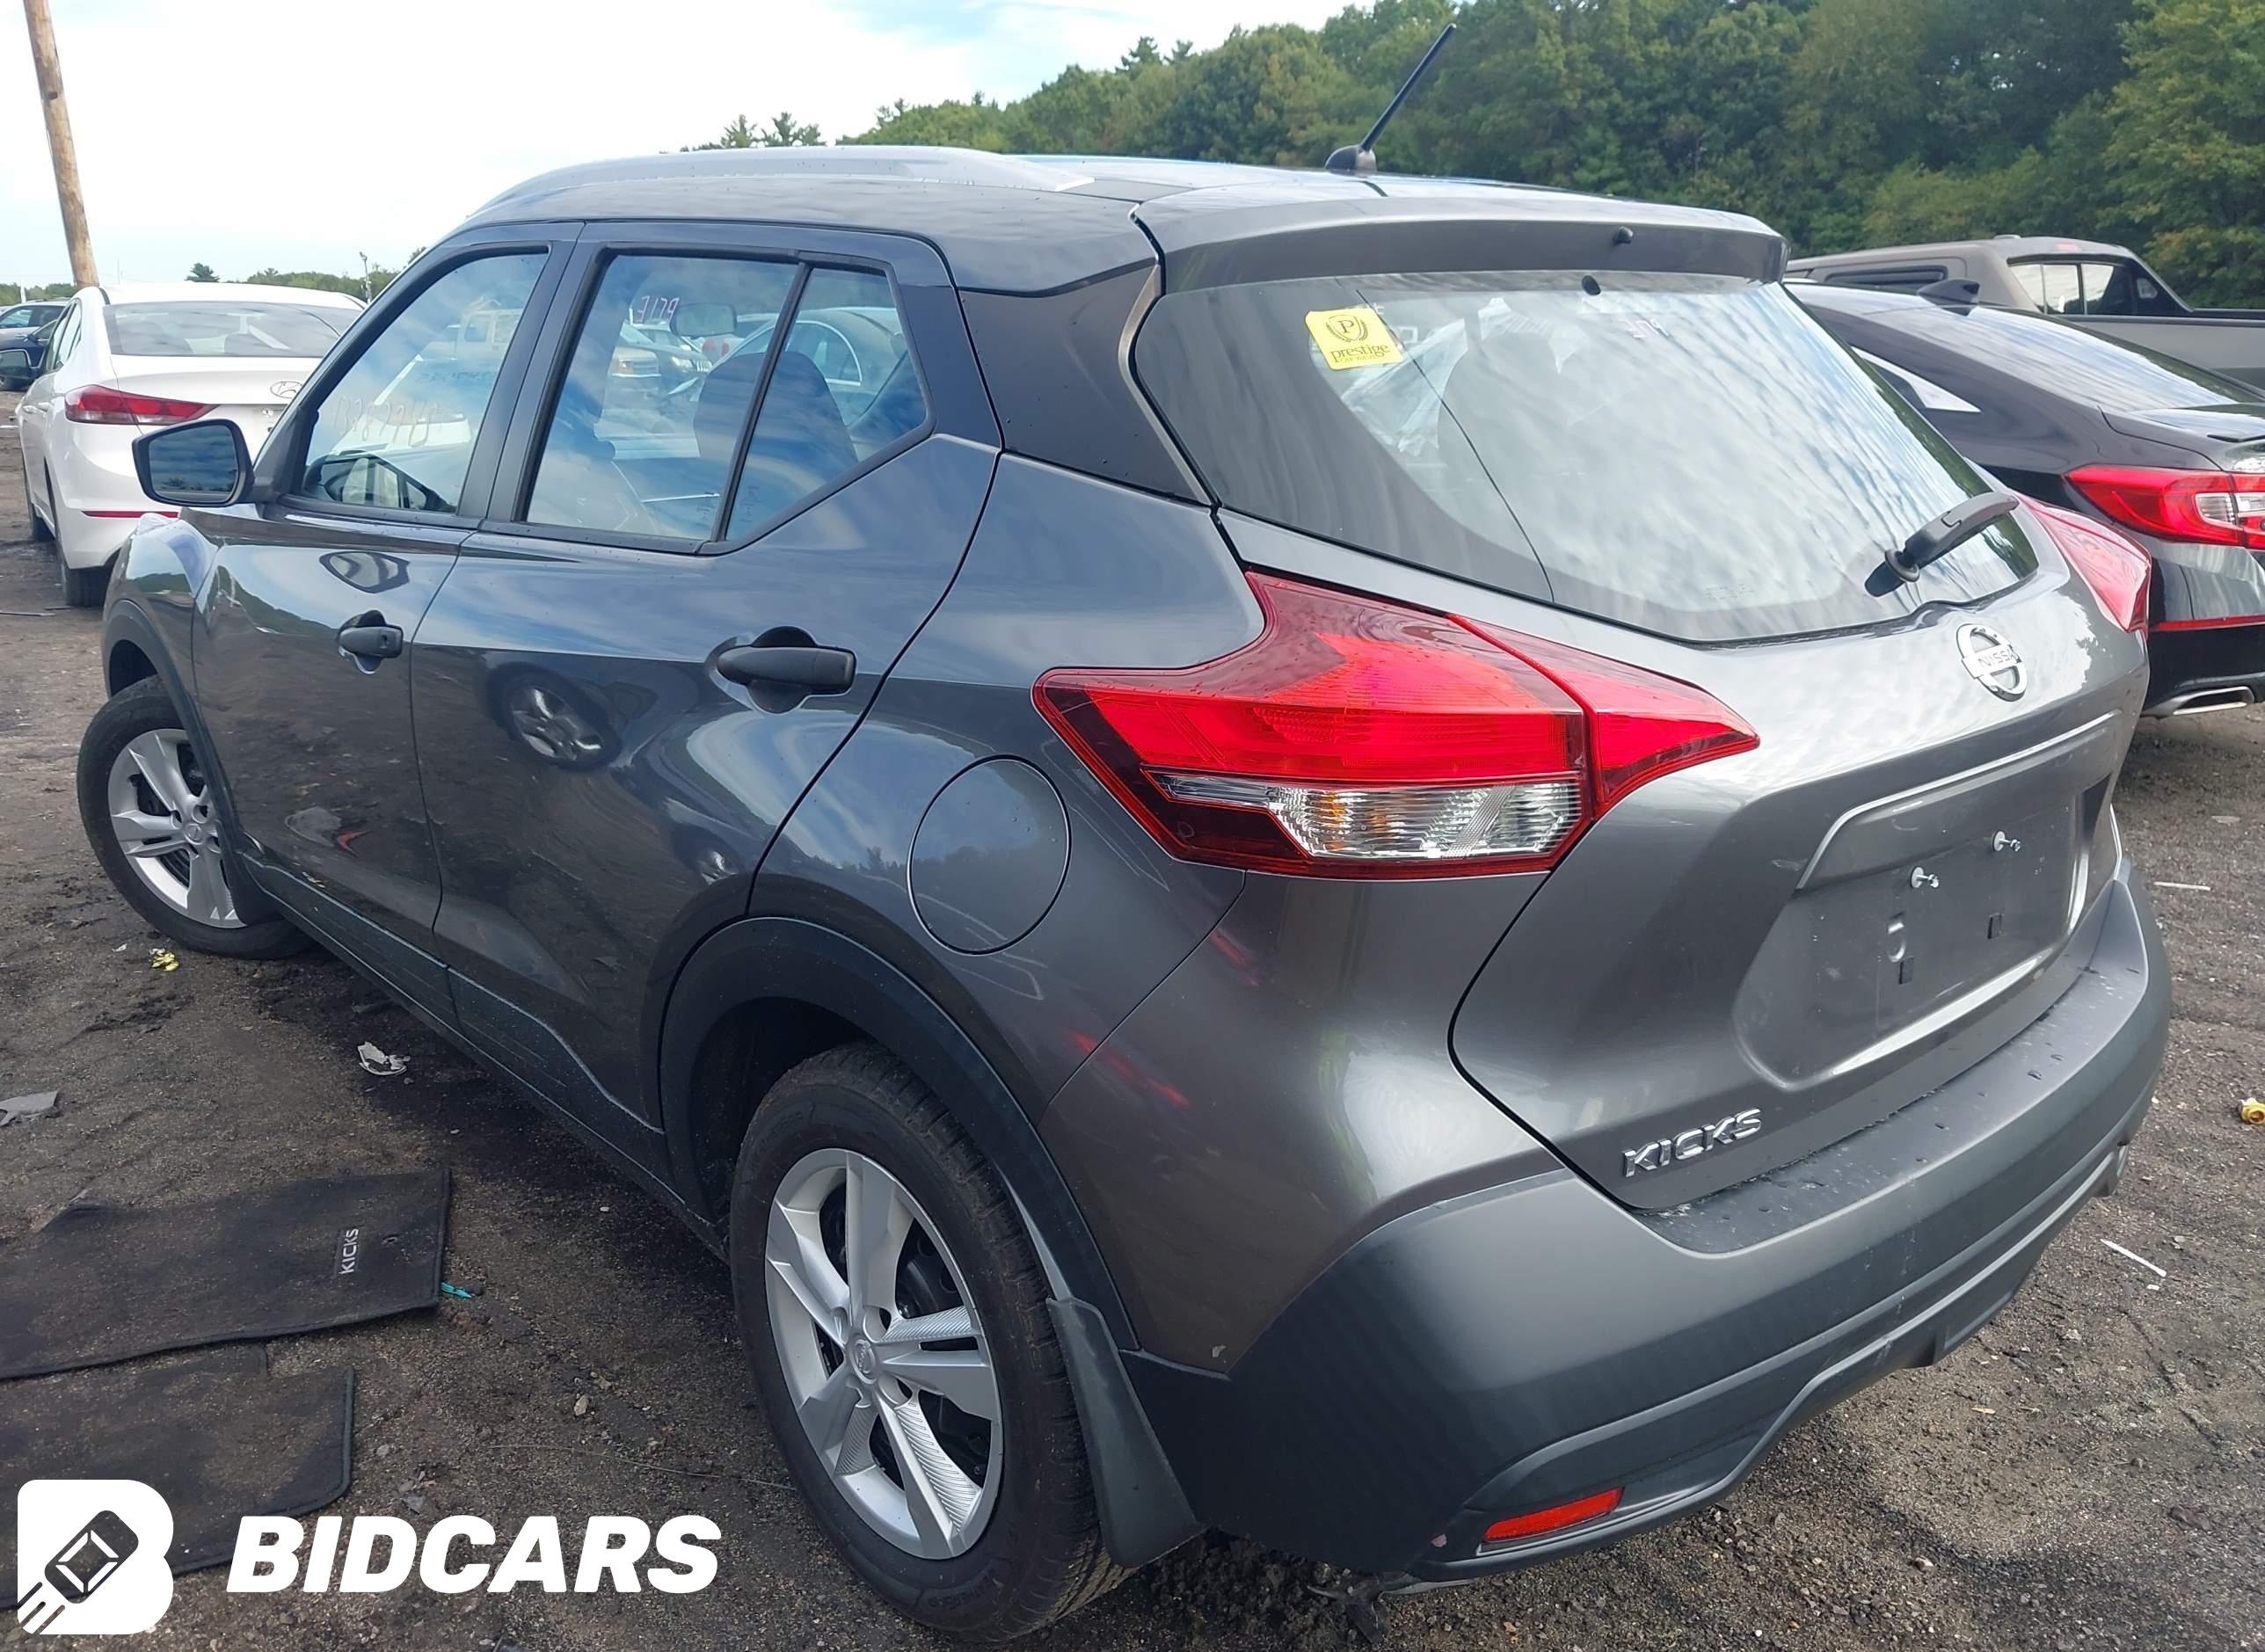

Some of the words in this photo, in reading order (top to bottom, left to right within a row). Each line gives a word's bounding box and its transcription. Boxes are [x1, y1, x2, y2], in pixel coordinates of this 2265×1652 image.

[1336, 319, 1354, 334] P
[1329, 344, 1391, 363] prestige
[1622, 1107, 1762, 1178] KICKS
[339, 1228, 360, 1275] KICKS
